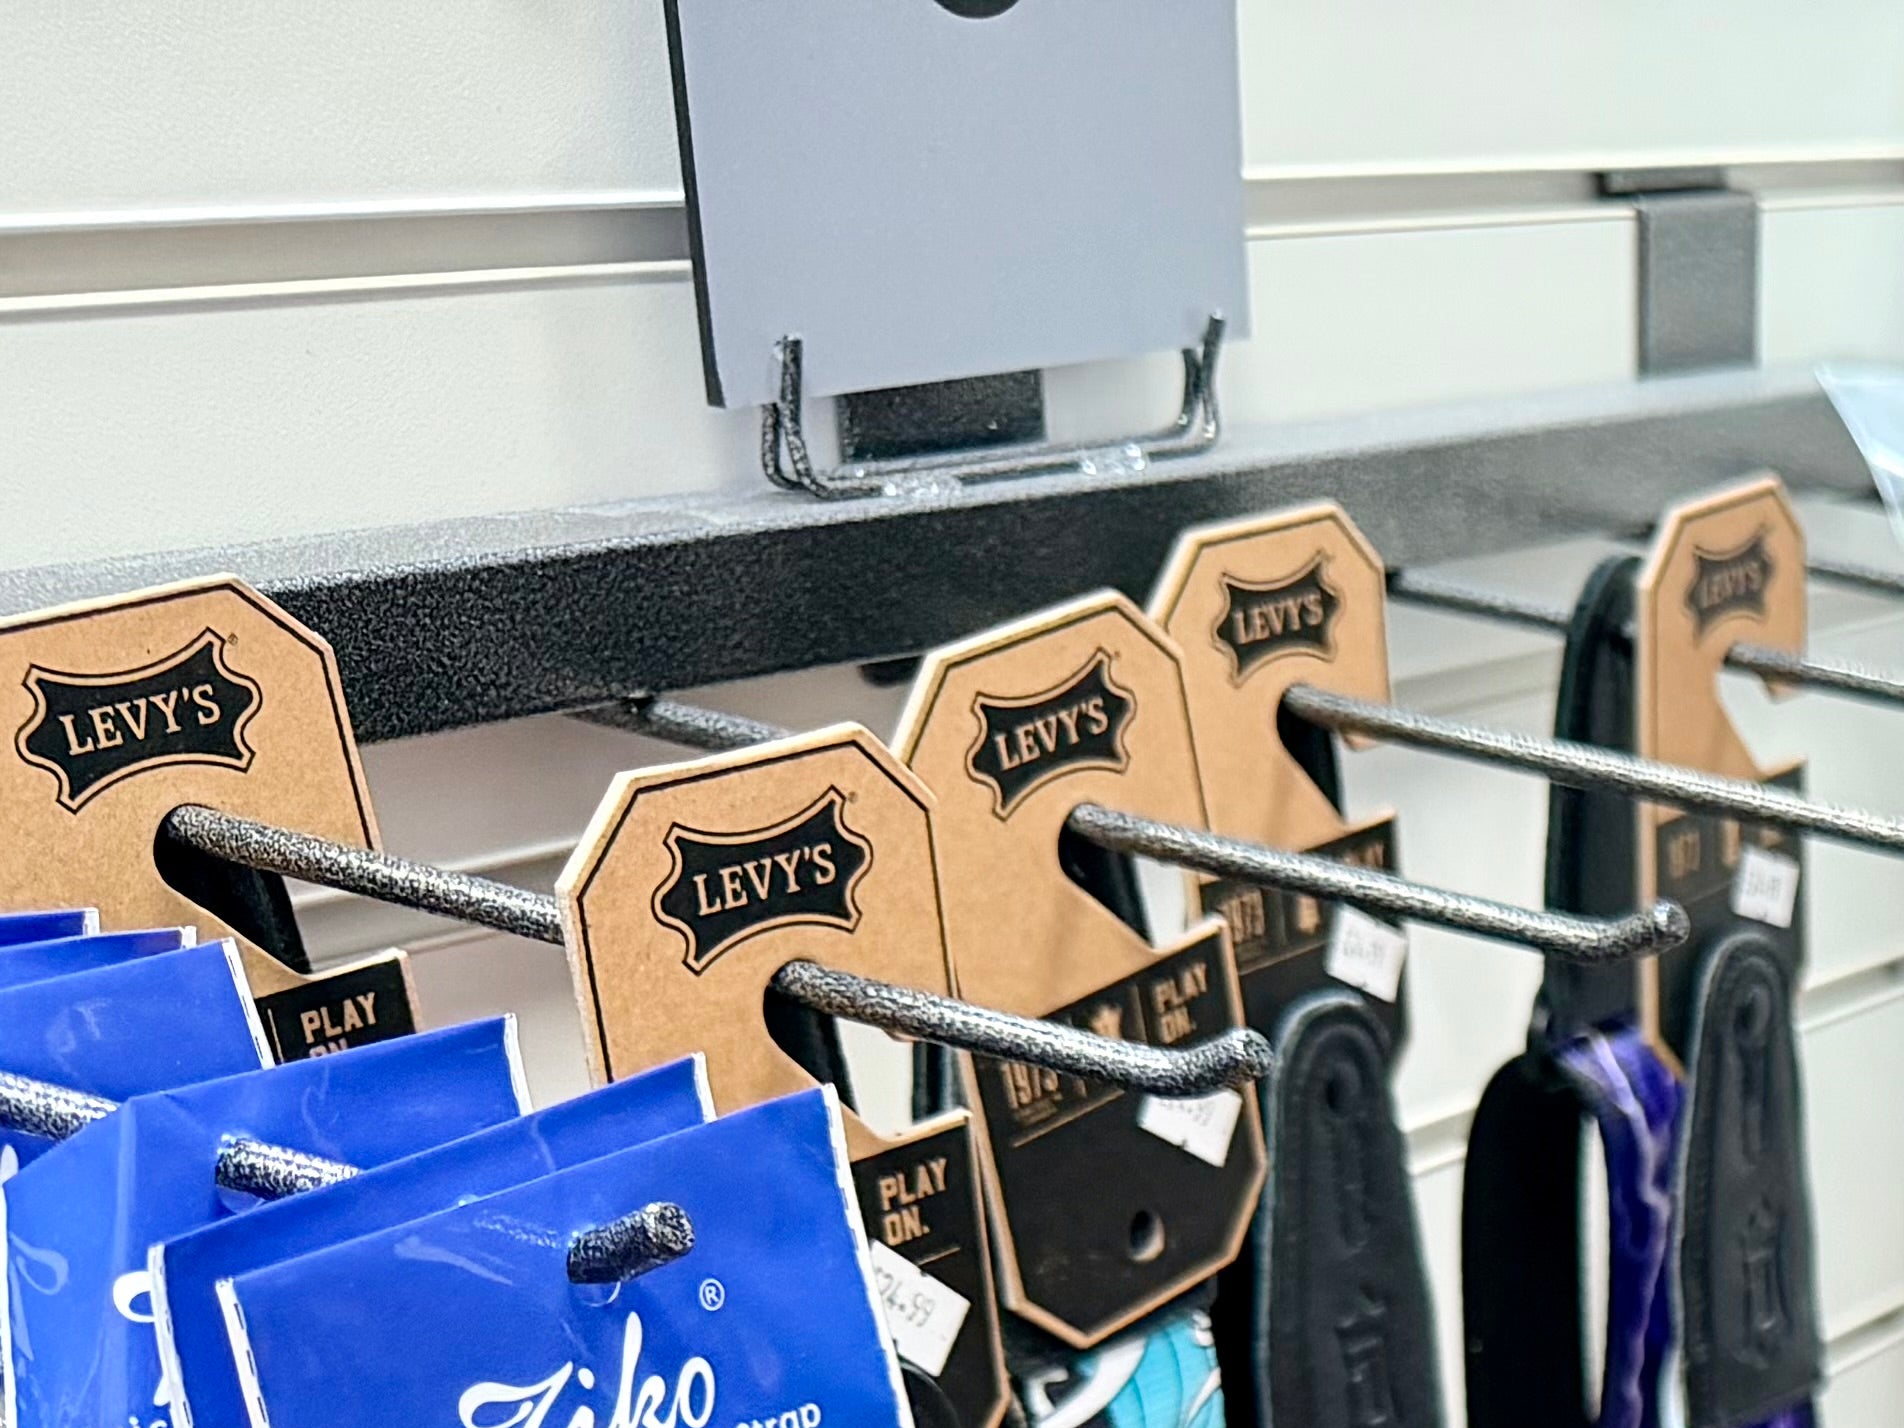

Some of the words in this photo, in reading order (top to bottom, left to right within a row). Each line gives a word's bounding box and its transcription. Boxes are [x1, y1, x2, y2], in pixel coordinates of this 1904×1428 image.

[1232, 593, 1322, 646] LEVY'S
[58, 684, 222, 757] LEVY'S
[995, 695, 1108, 770] LEVY'S
[693, 841, 837, 916] LEVY'S
[1151, 962, 1207, 1014] PLAY
[300, 992, 376, 1044] PLAY
[1157, 1009, 1197, 1043] ON.
[879, 1158, 947, 1211] PLAY
[884, 1206, 930, 1246] ON.
